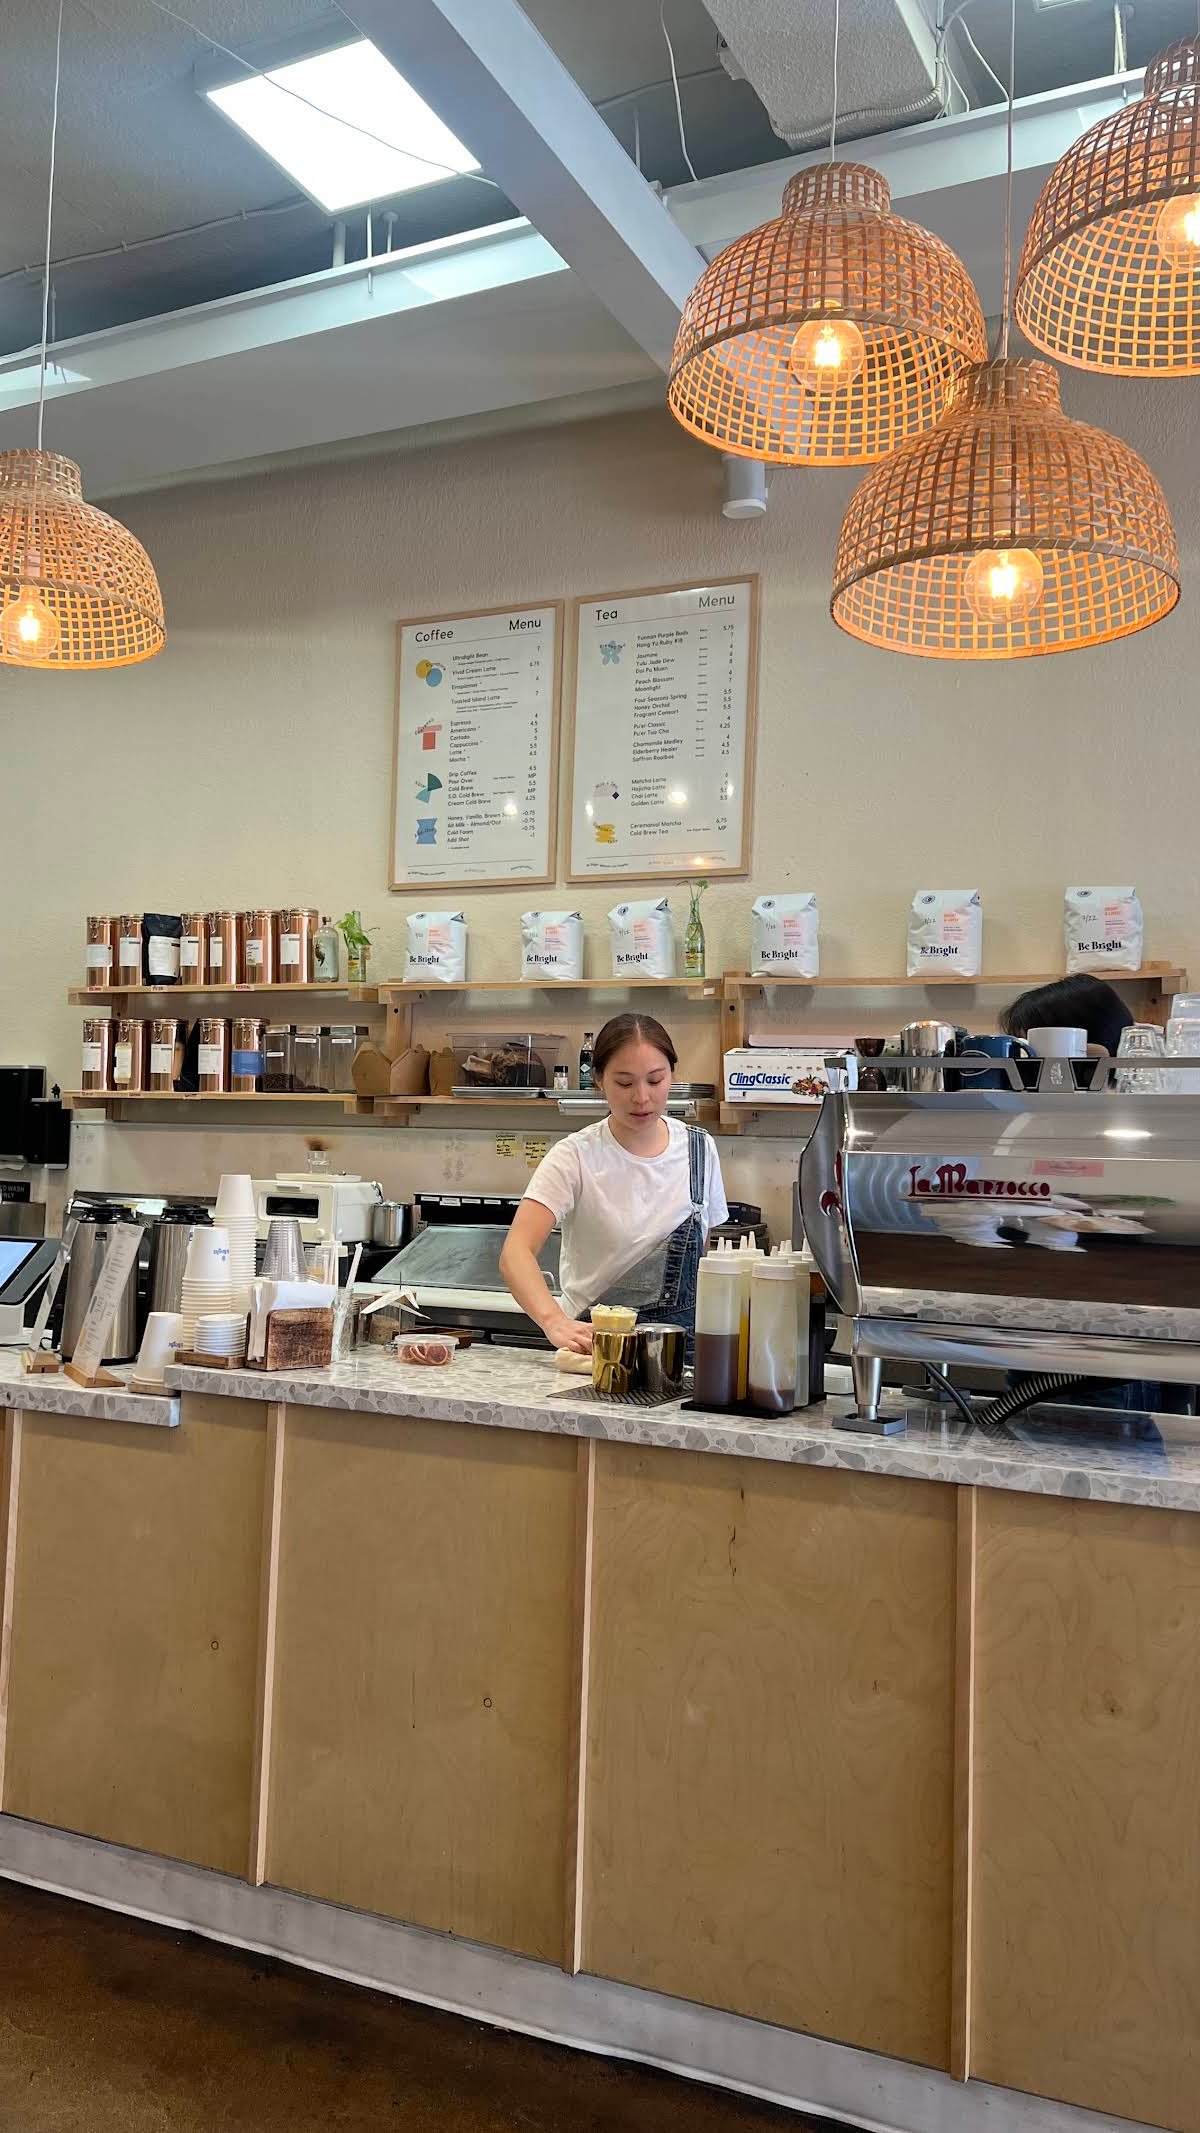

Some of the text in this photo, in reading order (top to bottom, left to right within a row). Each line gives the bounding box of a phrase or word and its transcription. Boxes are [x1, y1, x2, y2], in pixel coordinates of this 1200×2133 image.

[595, 596, 735, 620] Tea Menu
[415, 619, 541, 642] Coffee Menu
[632, 740, 663, 748] Chamomile
[632, 748, 660, 756] Elderberry
[630, 821, 661, 829] Ceremonial
[930, 945, 958, 957] Bright
[1078, 940, 1122, 952] Be Bright
[409, 954, 440, 965] Be Bright
[526, 954, 557, 965] Be Bright
[616, 952, 648, 963] Be Bright
[761, 949, 798, 960] Be Bright
[729, 1072, 791, 1086] ClingClassic
